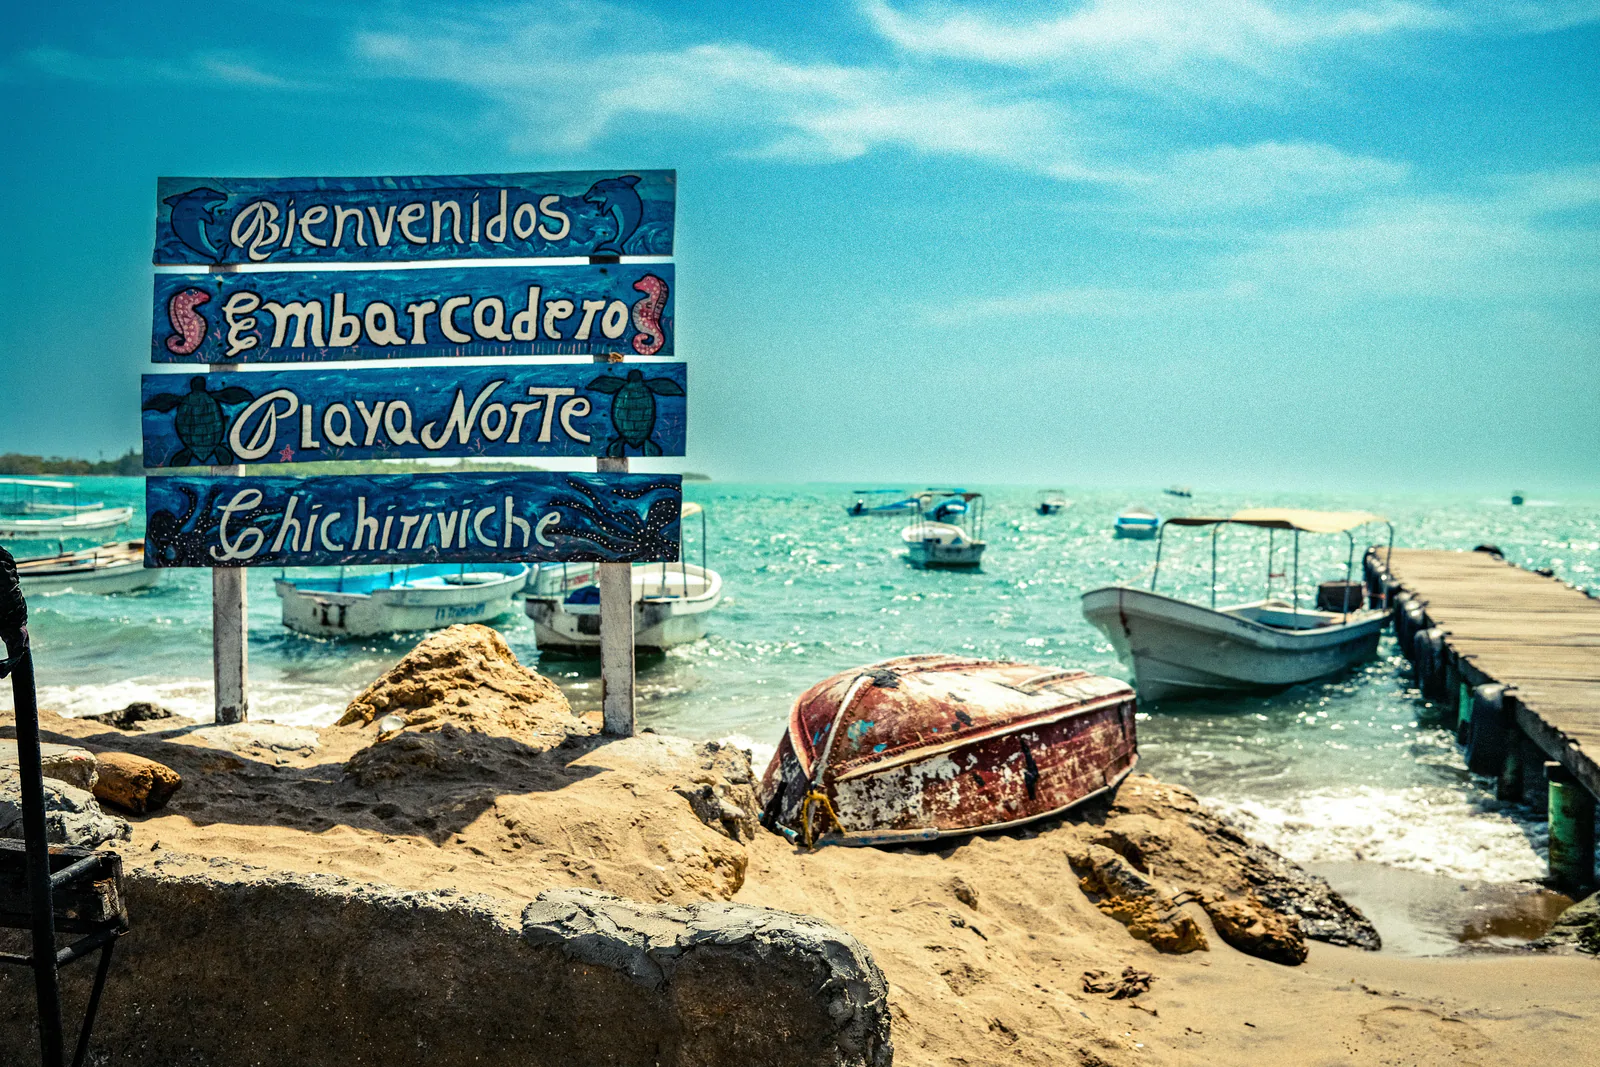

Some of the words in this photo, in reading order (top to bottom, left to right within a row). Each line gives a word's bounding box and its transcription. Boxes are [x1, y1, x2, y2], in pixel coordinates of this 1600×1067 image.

[230, 189, 570, 261] Bienvenidos
[222, 286, 628, 357] Embarcadero
[209, 489, 562, 560] Chichiriviche
